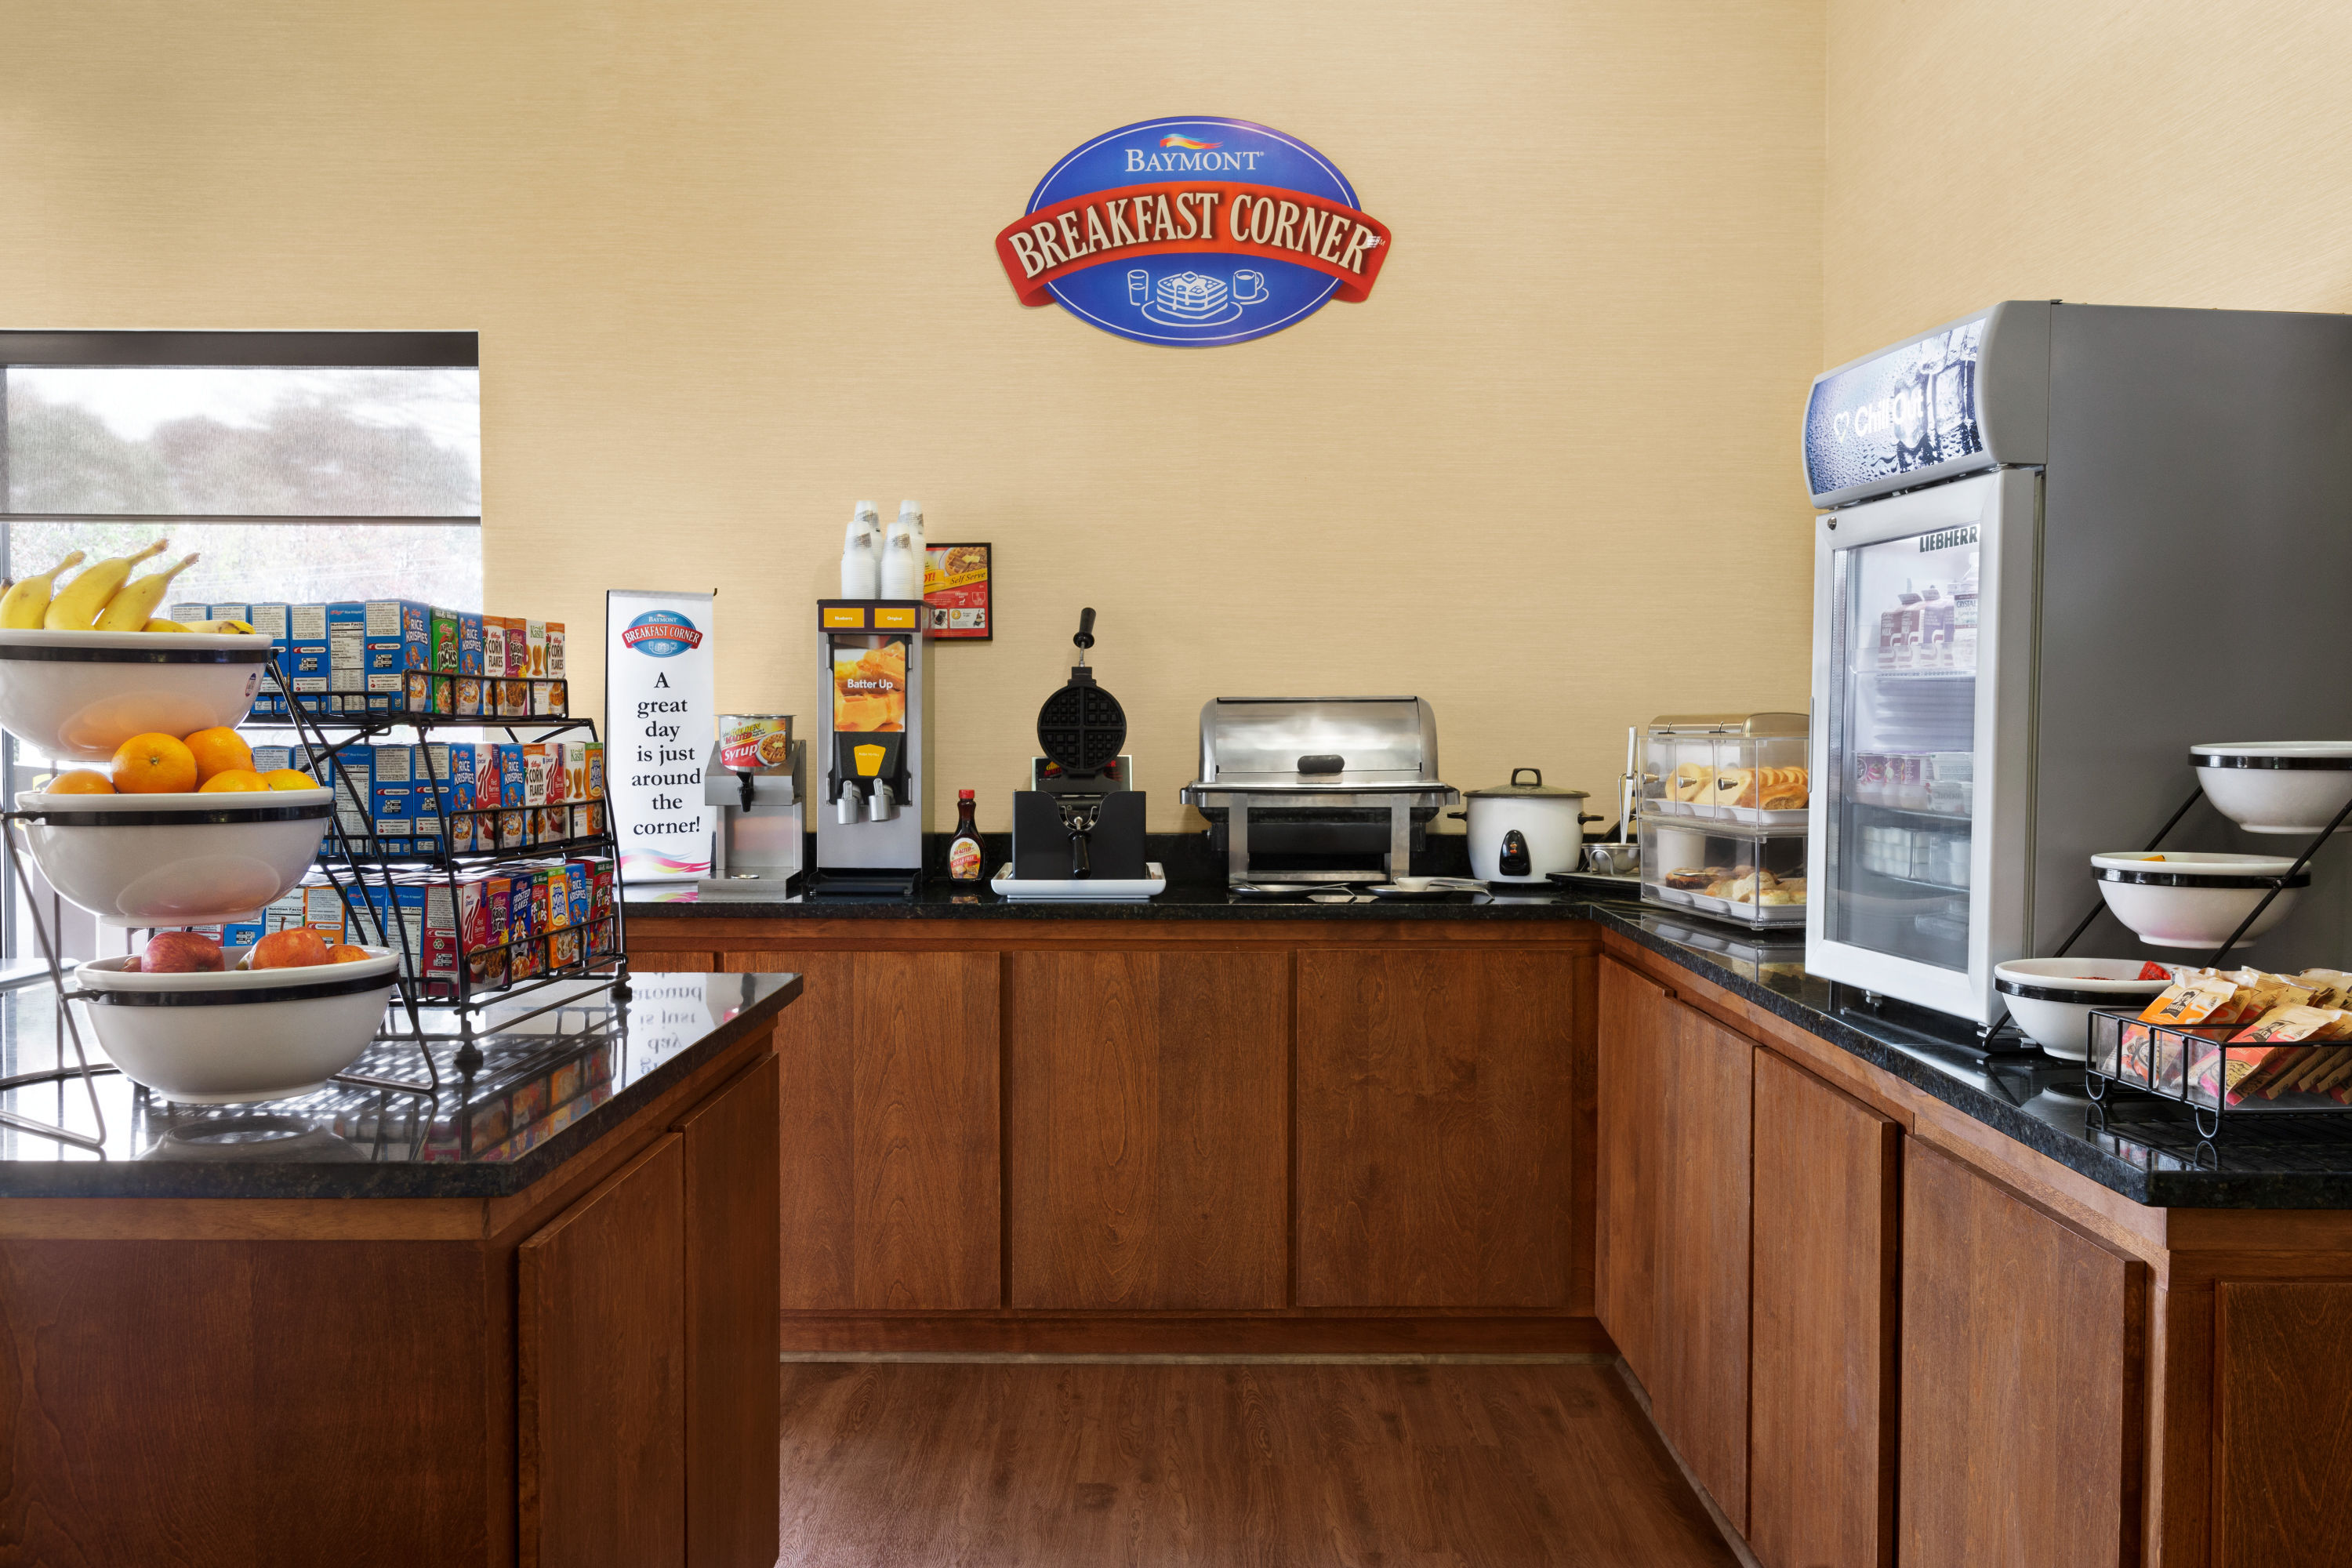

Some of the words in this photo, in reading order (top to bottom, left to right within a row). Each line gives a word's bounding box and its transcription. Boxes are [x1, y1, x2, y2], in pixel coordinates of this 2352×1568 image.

[1124, 148, 1260, 172] BAYMONT
[1008, 191, 1219, 279] BREAKFAST
[1229, 194, 1374, 275] CORNER
[1855, 401, 1889, 437] Chill
[1892, 391, 1924, 425] Out
[1920, 526, 1978, 553] LIEBHERR
[950, 575, 965, 585] Self
[966, 572, 985, 582] Serve
[410, 618, 423, 631] RICE
[530, 625, 544, 638] Kashi
[406, 630, 428, 644] KRISPIES
[466, 629, 478, 640] RICE
[624, 626, 668, 643] BREAKFAST
[670, 626, 699, 644] CORNER
[462, 640, 481, 652] KRISPIES
[488, 640, 503, 654] CORN
[510, 642, 524, 655] Raisin
[551, 644, 564, 658] CORN
[488, 655, 503, 667] FLAKES
[511, 654, 523, 666] Bran
[551, 659, 564, 670] FLAKES
[654, 672, 670, 688] A
[848, 678, 877, 689] Batter
[879, 678, 893, 690] Up
[637, 699, 688, 718] great
[645, 720, 681, 742] day
[731, 722, 760, 736] GOLDEN
[725, 731, 753, 745] MALTED
[637, 745, 652, 762] is
[659, 745, 695, 766] just
[724, 744, 759, 762] Syrup
[459, 760, 470, 772] RICE
[508, 761, 519, 772] RICE
[455, 772, 474, 786] KRISPIES
[477, 758, 492, 801] K
[504, 772, 523, 786] KRISPIES
[529, 768, 543, 782] CORN
[631, 768, 701, 786] around
[529, 784, 544, 797] FLAKES
[652, 793, 683, 810] the
[633, 816, 700, 835] corner!
[572, 879, 583, 891] RICE
[513, 888, 531, 905] FROSTED
[553, 893, 565, 906] Mini
[569, 890, 586, 903] KRISPIES
[513, 898, 528, 913] FLAKES
[2169, 1004, 2185, 1013] QUAKER
